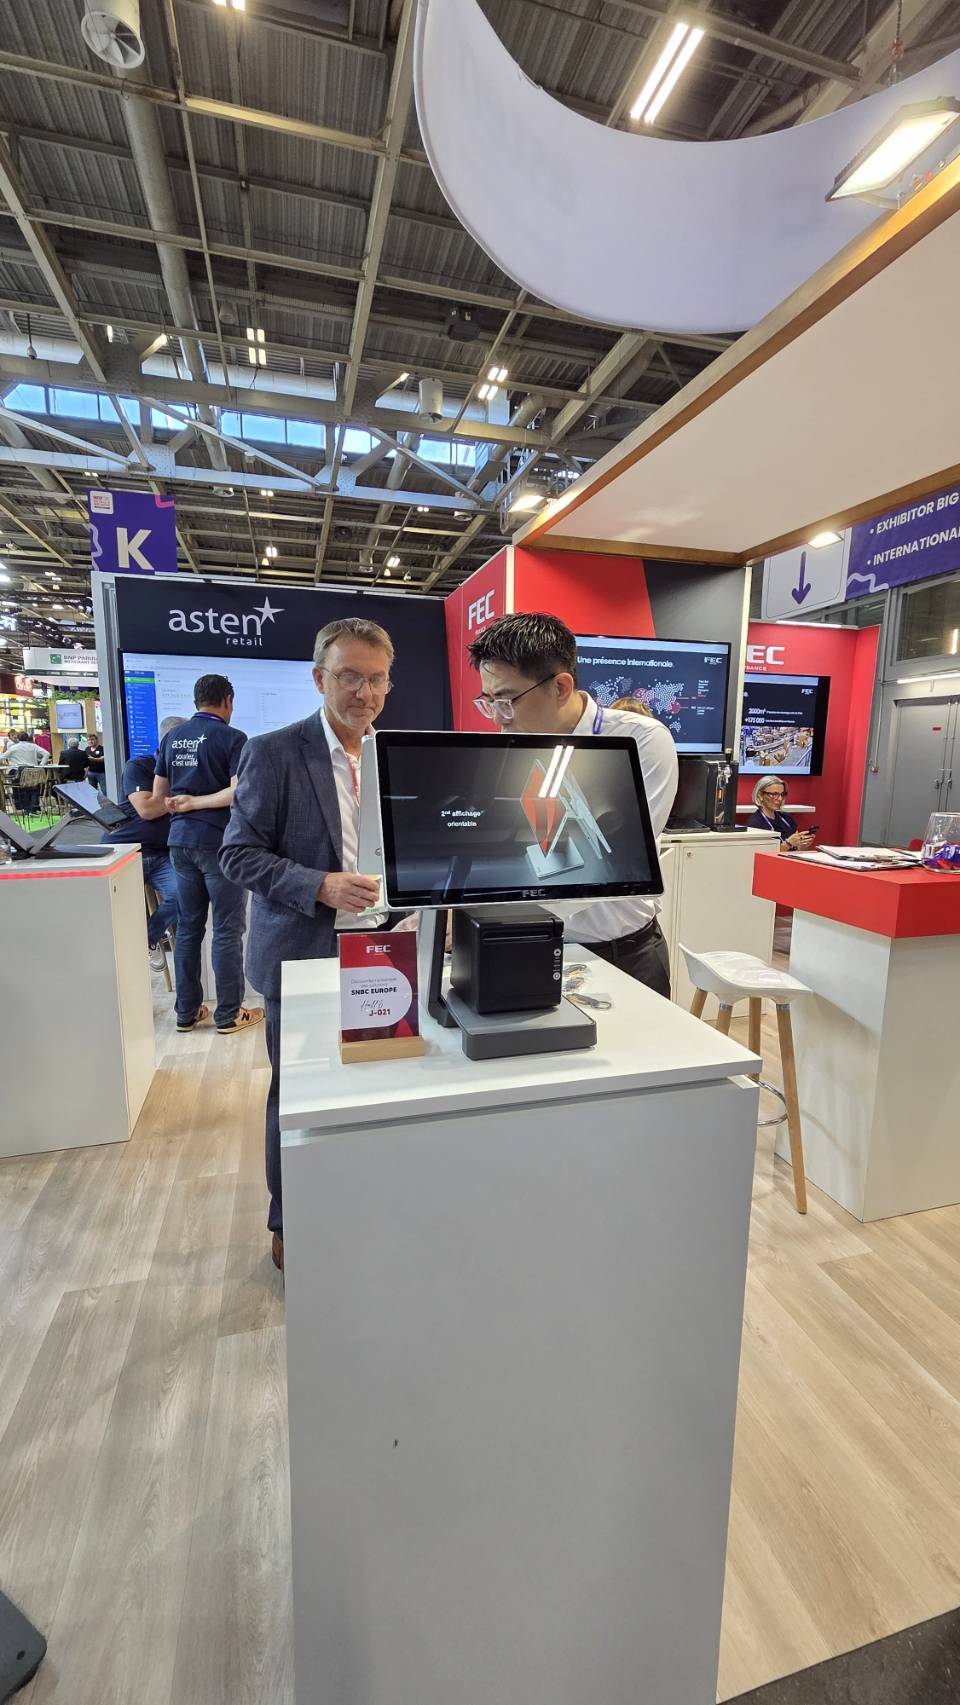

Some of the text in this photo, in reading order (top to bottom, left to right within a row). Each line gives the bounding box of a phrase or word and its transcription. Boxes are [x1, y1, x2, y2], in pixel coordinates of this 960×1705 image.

[876, 492, 960, 534] EXHIBITOR BIG
[116, 527, 155, 570] K
[468, 589, 496, 630] FEC
[168, 607, 262, 636] asten
[226, 637, 263, 646] retail
[746, 644, 785, 665] EC
[577, 655, 592, 664] Une
[592, 656, 627, 666] présence
[704, 656, 723, 664] FEC
[172, 739, 199, 748] asten
[521, 888, 546, 898] FEC
[366, 945, 391, 953] FEC
[370, 986, 398, 994] EUROPE
